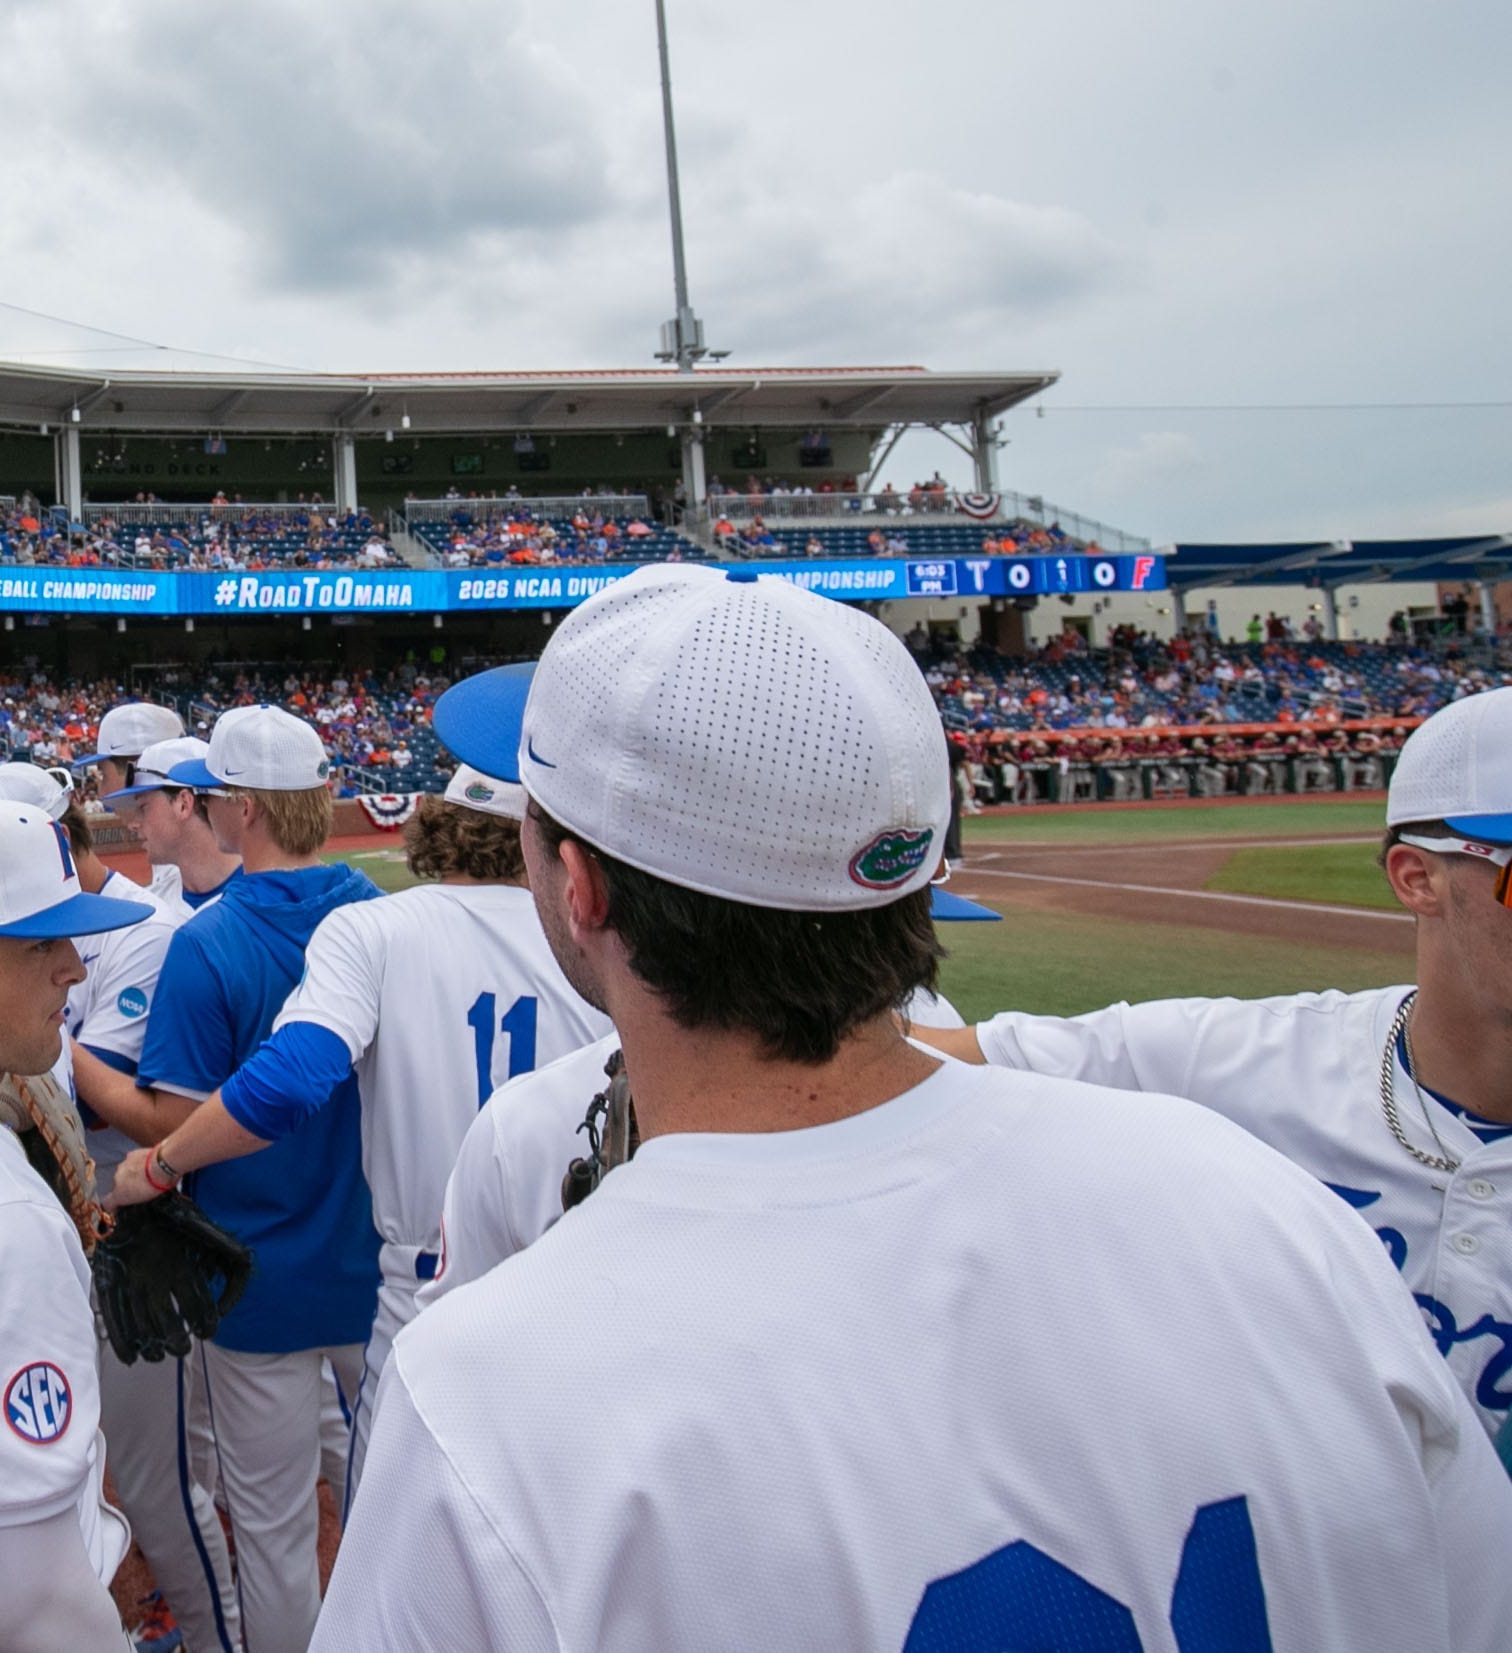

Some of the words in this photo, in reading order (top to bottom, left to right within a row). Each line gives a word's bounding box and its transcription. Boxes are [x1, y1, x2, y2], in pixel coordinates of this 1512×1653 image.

[921, 581, 943, 593] PM
[966, 561, 991, 591] T
[1131, 556, 1155, 589] F
[43, 581, 157, 602] CHAMPIONSHIP
[459, 579, 509, 600] 2026
[514, 577, 562, 598] NCAA
[467, 991, 538, 1113] 11
[8, 1365, 69, 1440] SEC
